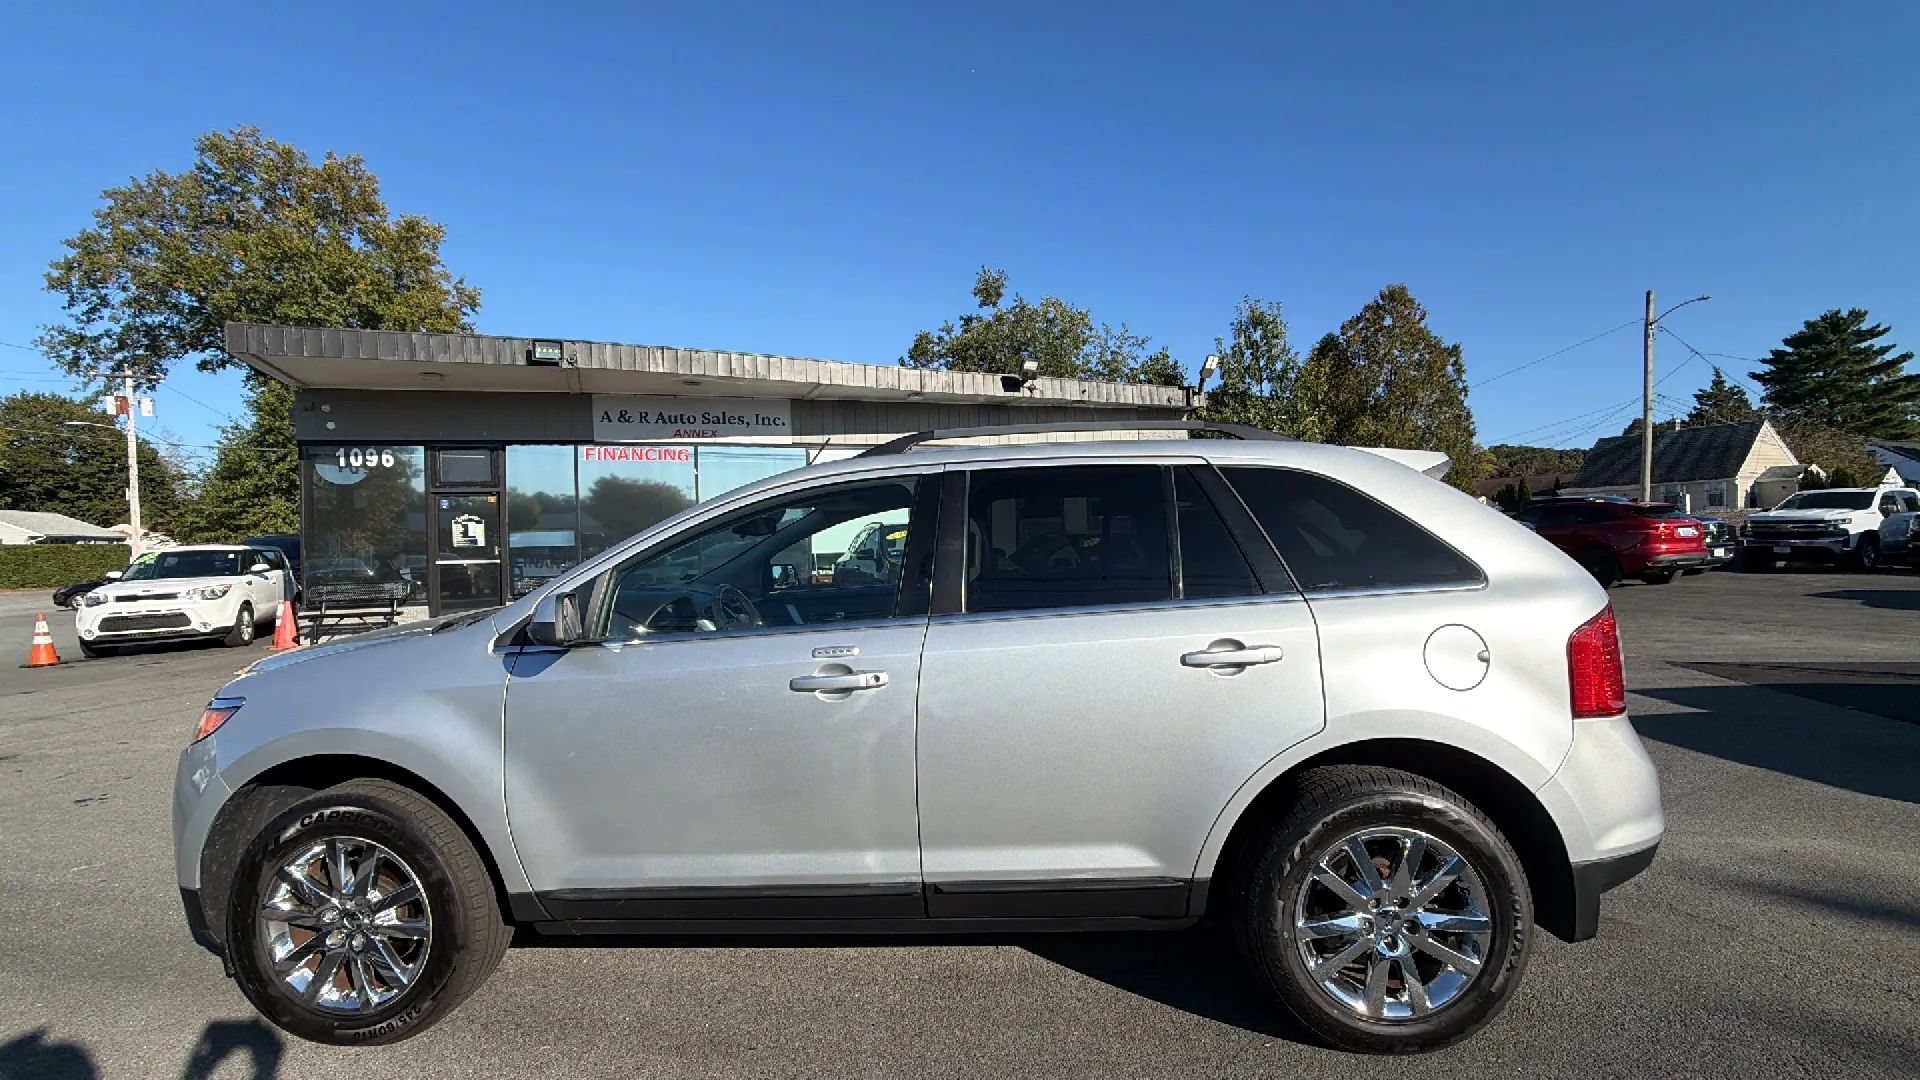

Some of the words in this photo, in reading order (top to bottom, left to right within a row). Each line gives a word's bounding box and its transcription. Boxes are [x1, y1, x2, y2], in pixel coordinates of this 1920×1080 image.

[600, 410, 613, 423] A
[617, 409, 634, 424] &
[638, 411, 651, 424] R
[654, 411, 697, 425] Auto
[701, 411, 750, 429] Sales,
[754, 413, 787, 427] Inc.
[672, 428, 719, 438] ANNEX
[335, 447, 395, 468] 1096
[585, 447, 690, 461] FINANCING
